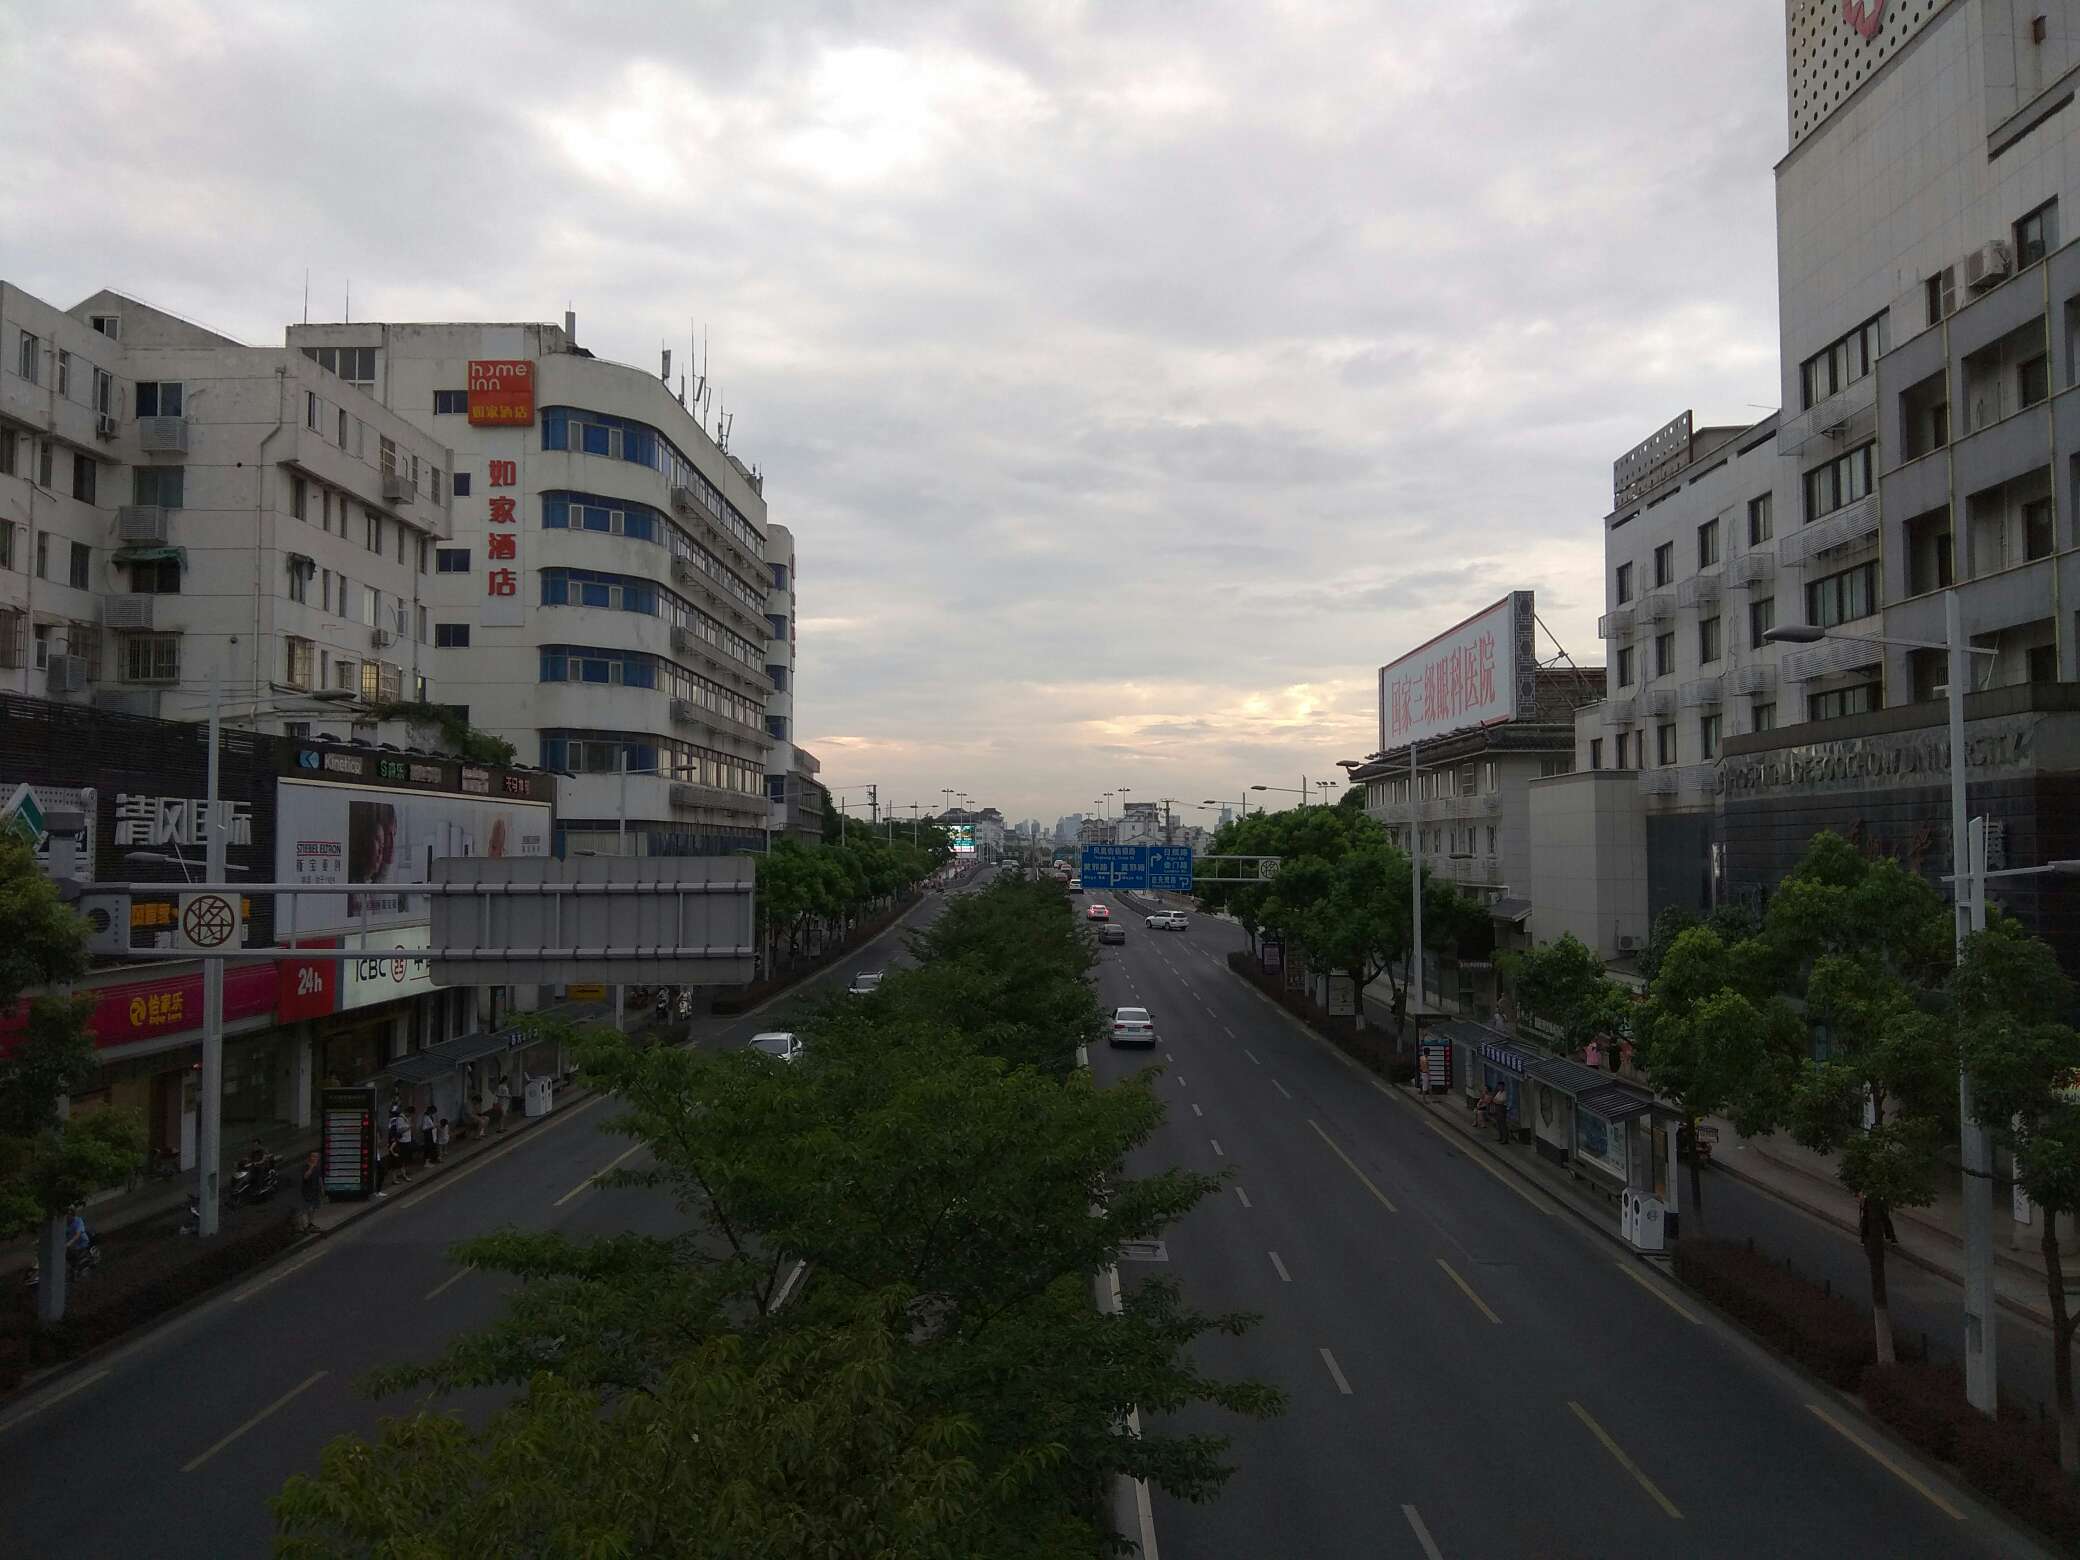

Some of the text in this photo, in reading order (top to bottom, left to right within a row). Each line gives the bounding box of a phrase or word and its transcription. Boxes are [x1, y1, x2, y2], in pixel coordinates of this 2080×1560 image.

[471, 362, 528, 377] home
[471, 377, 501, 391] inn
[471, 405, 529, 419] 如家酒店
[488, 459, 517, 597] 如家酒店
[1391, 631, 1496, 738] 国家三级眼科医院
[297, 967, 323, 996] 24h
[355, 959, 386, 983] ICBC
